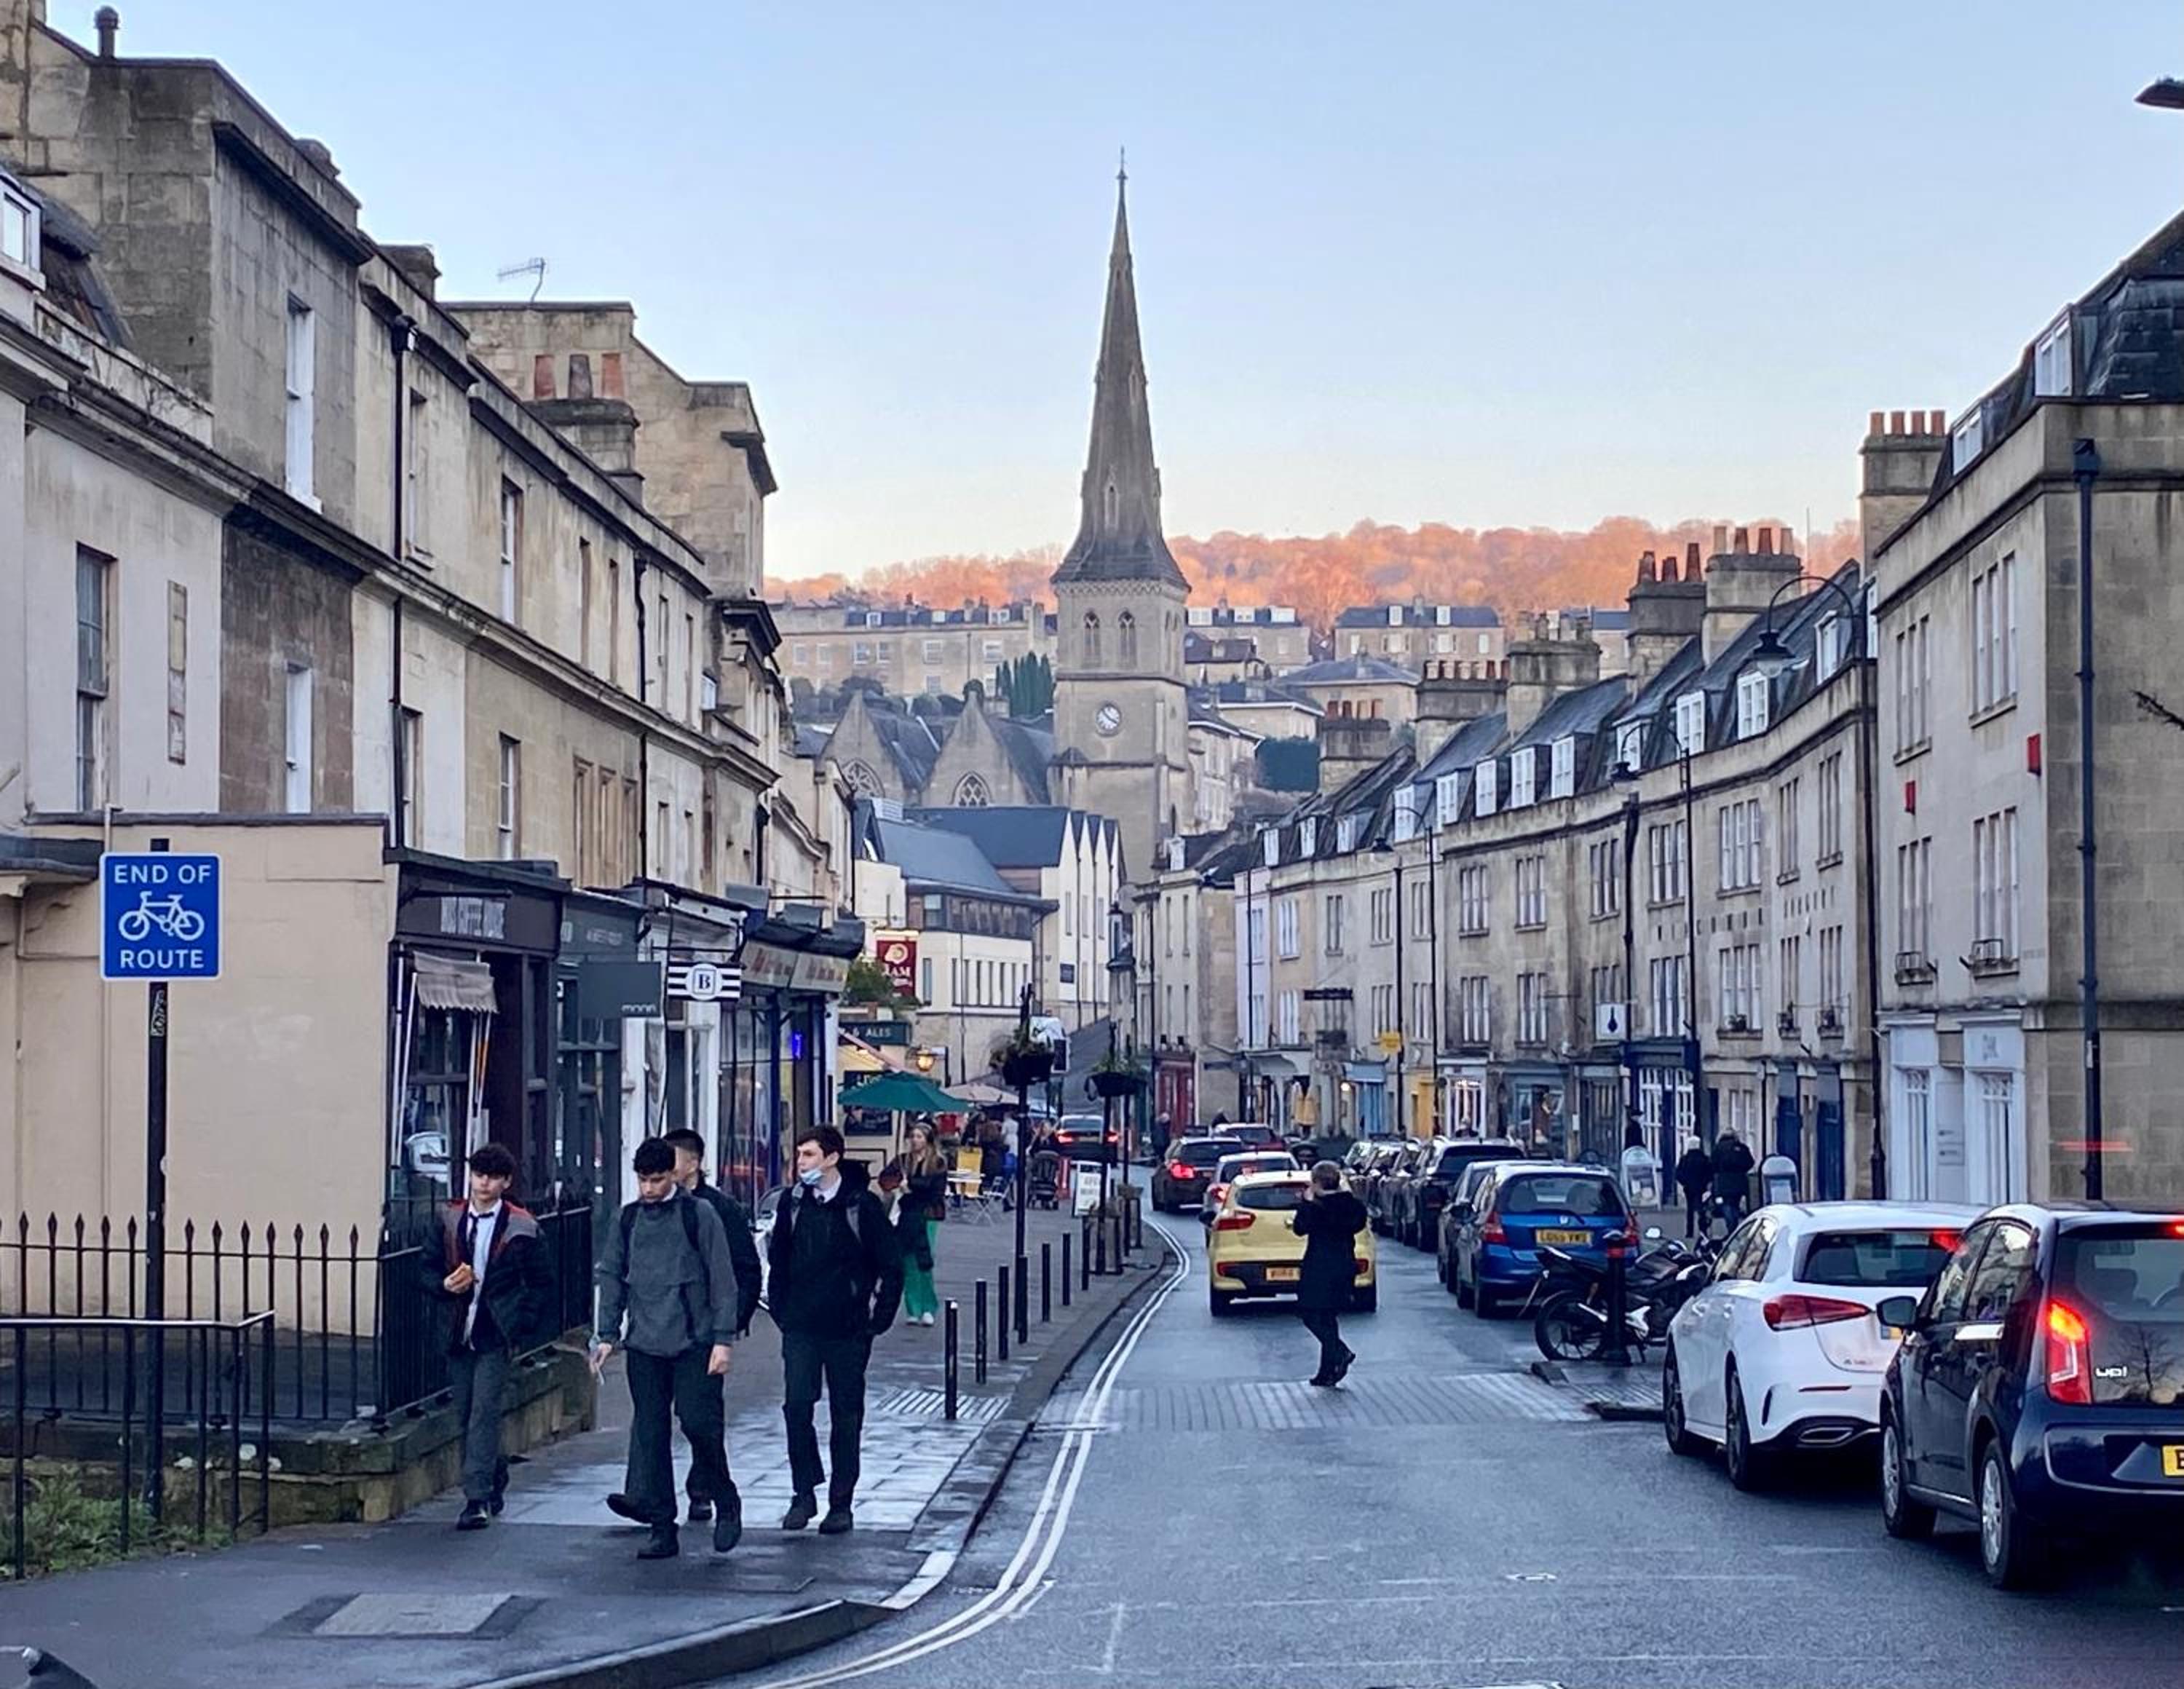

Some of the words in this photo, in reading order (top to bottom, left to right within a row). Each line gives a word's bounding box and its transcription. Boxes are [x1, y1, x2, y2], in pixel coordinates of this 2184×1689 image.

[114, 864, 168, 884] END
[178, 864, 211, 884] OF
[120, 949, 204, 968] ROUTE
[698, 973, 711, 989] B
[866, 1027, 892, 1037] ALES
[2096, 1366, 2127, 1377] up!
